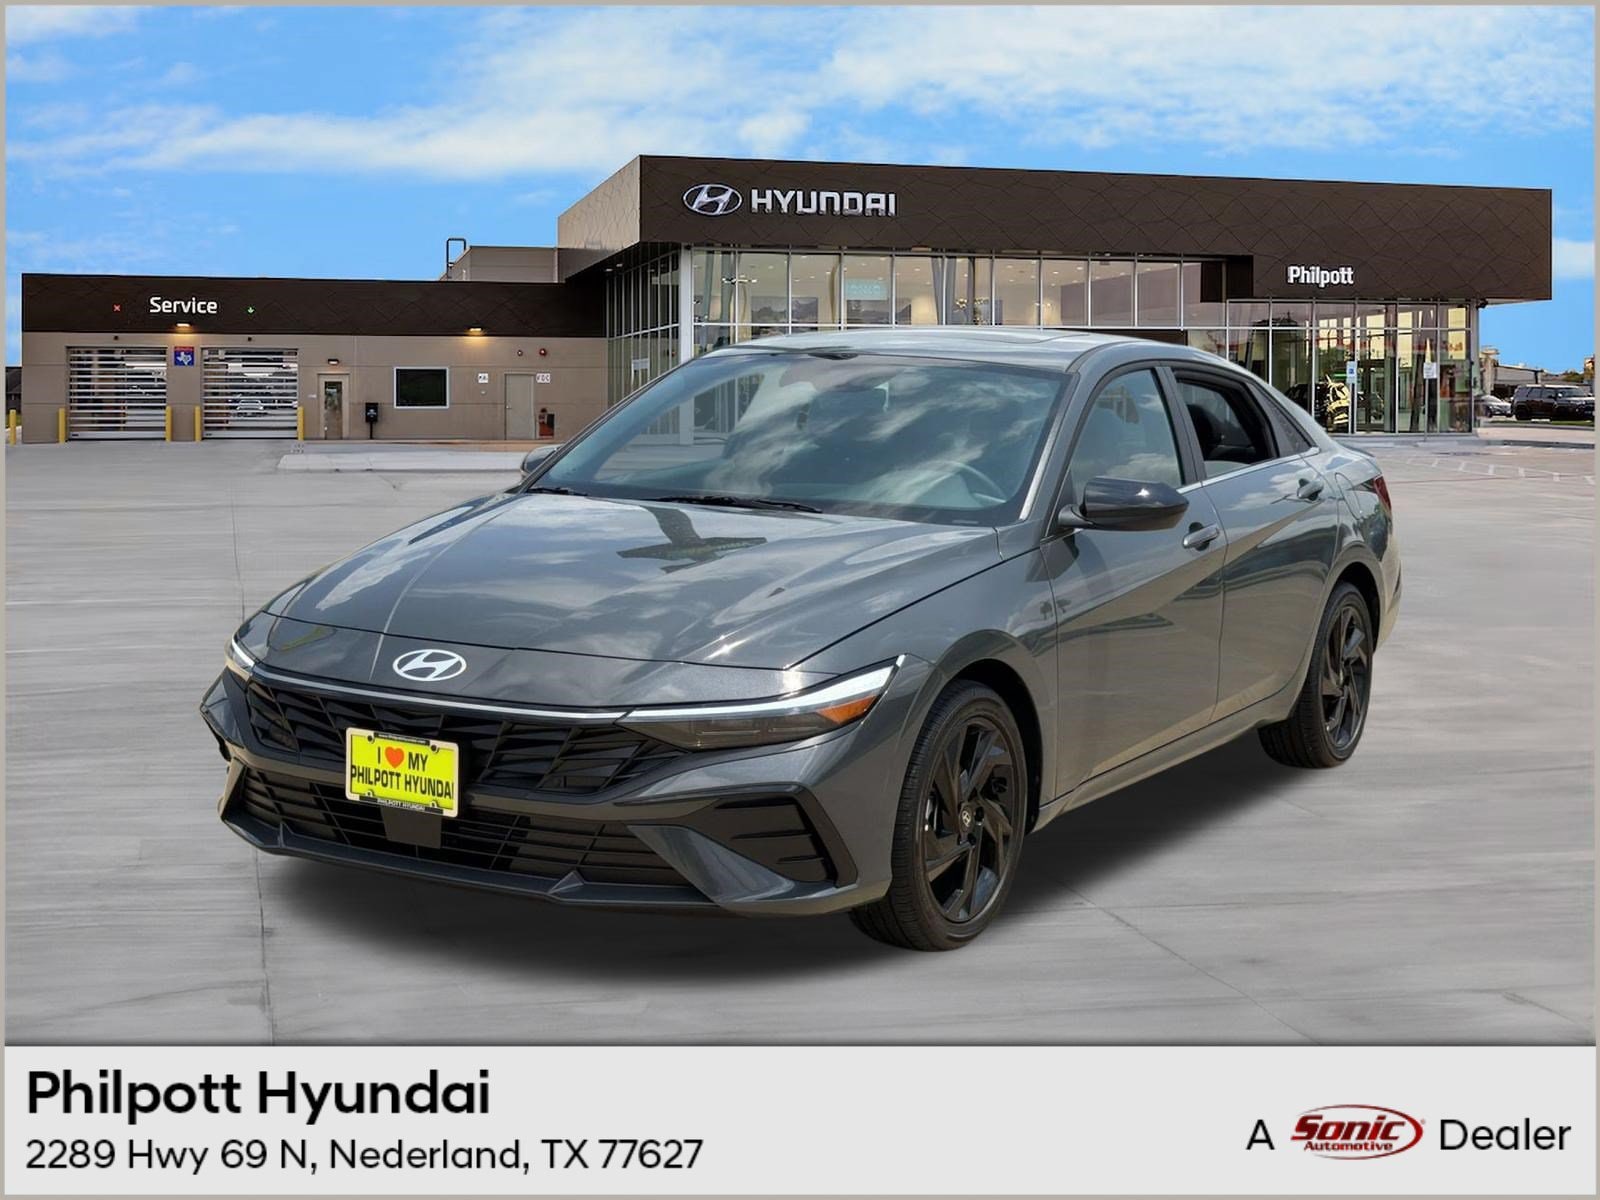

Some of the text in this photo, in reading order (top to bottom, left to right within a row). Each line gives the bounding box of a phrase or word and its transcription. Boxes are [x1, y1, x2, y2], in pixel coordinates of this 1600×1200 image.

[750, 188, 896, 216] HYUNDAI
[1287, 265, 1355, 288] Philpott
[149, 296, 218, 315] Service
[377, 746, 428, 772] I MY
[351, 765, 401, 790] PHILPOTT
